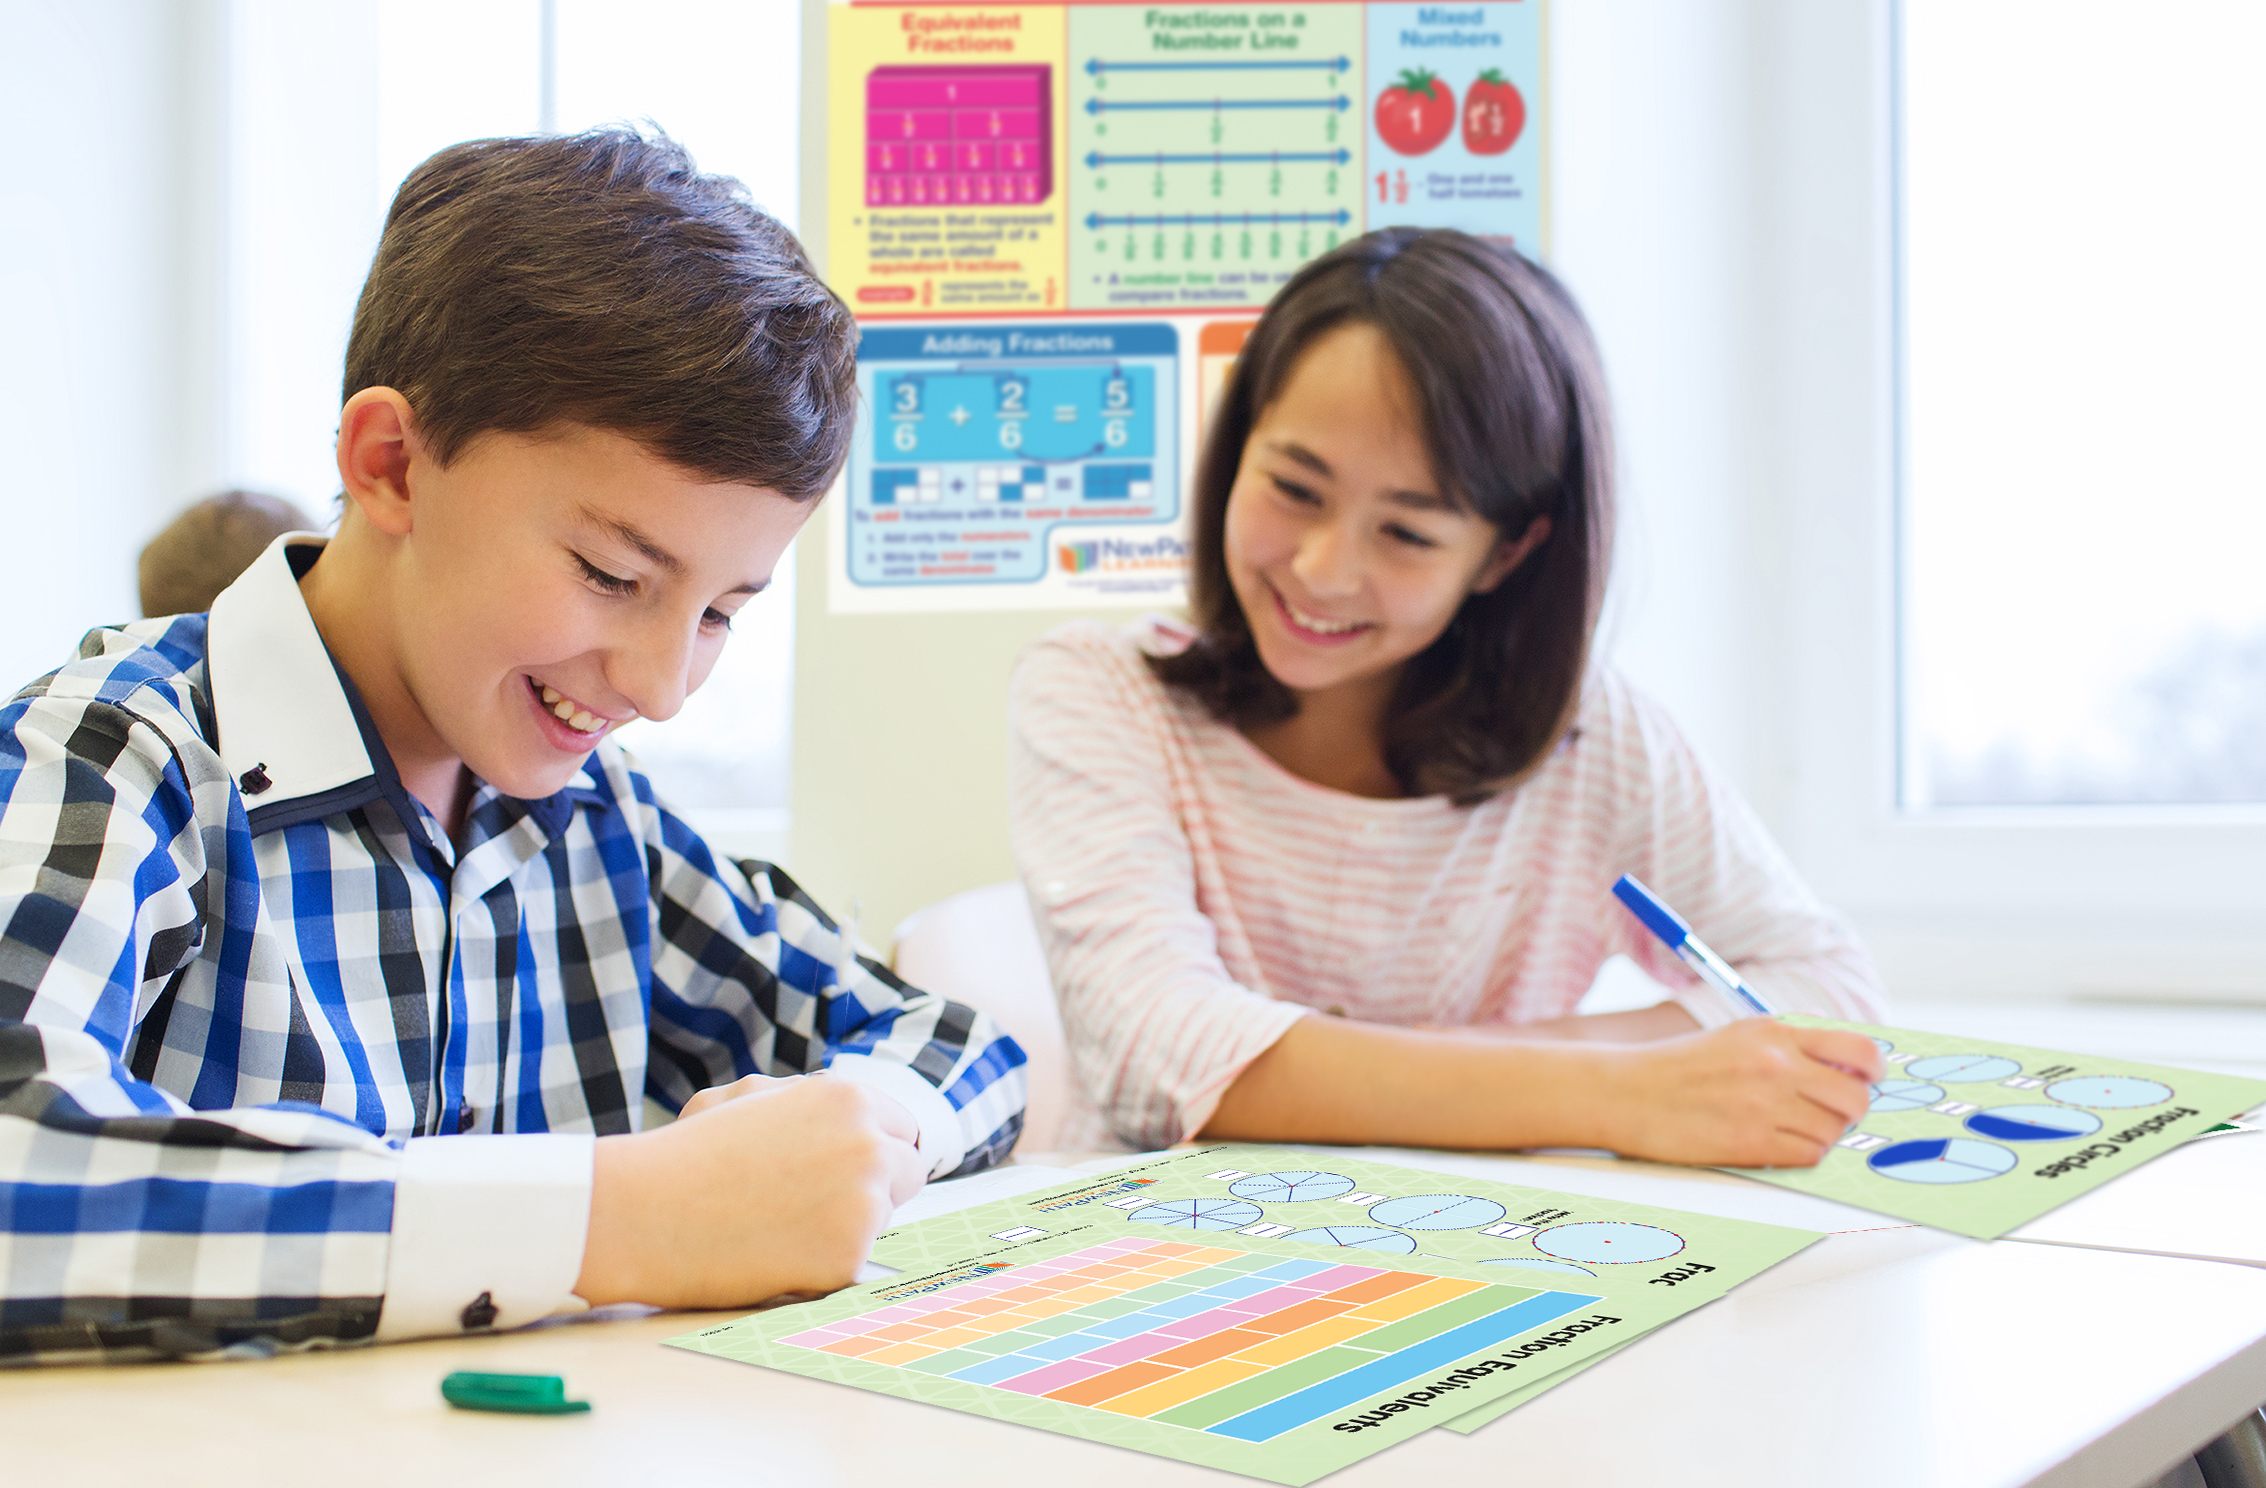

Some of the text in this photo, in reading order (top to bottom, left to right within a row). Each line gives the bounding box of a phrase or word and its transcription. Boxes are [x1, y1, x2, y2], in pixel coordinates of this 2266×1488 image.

[901, 12, 1022, 34] Equivalent
[1145, 10, 1306, 28] Fractions on a
[1418, 9, 1485, 26] Mixed
[907, 35, 1015, 53] Fractions
[1152, 32, 1299, 50] Number Line
[1400, 31, 1502, 47] Numbers
[1408, 106, 1421, 134] 1
[1373, 169, 1389, 205] 1
[922, 333, 1114, 357] Adding Fractions
[895, 383, 918, 413] 3
[1001, 382, 1024, 410] 2
[1106, 380, 1128, 409] 5
[894, 423, 917, 452] 6
[1000, 421, 1022, 450] 6
[1105, 419, 1127, 448] 6
[2034, 1106, 2200, 1179] Fraction Circles
[1648, 1262, 1716, 1287] Frac
[1333, 1315, 1622, 1433] Fraction Equivalents
